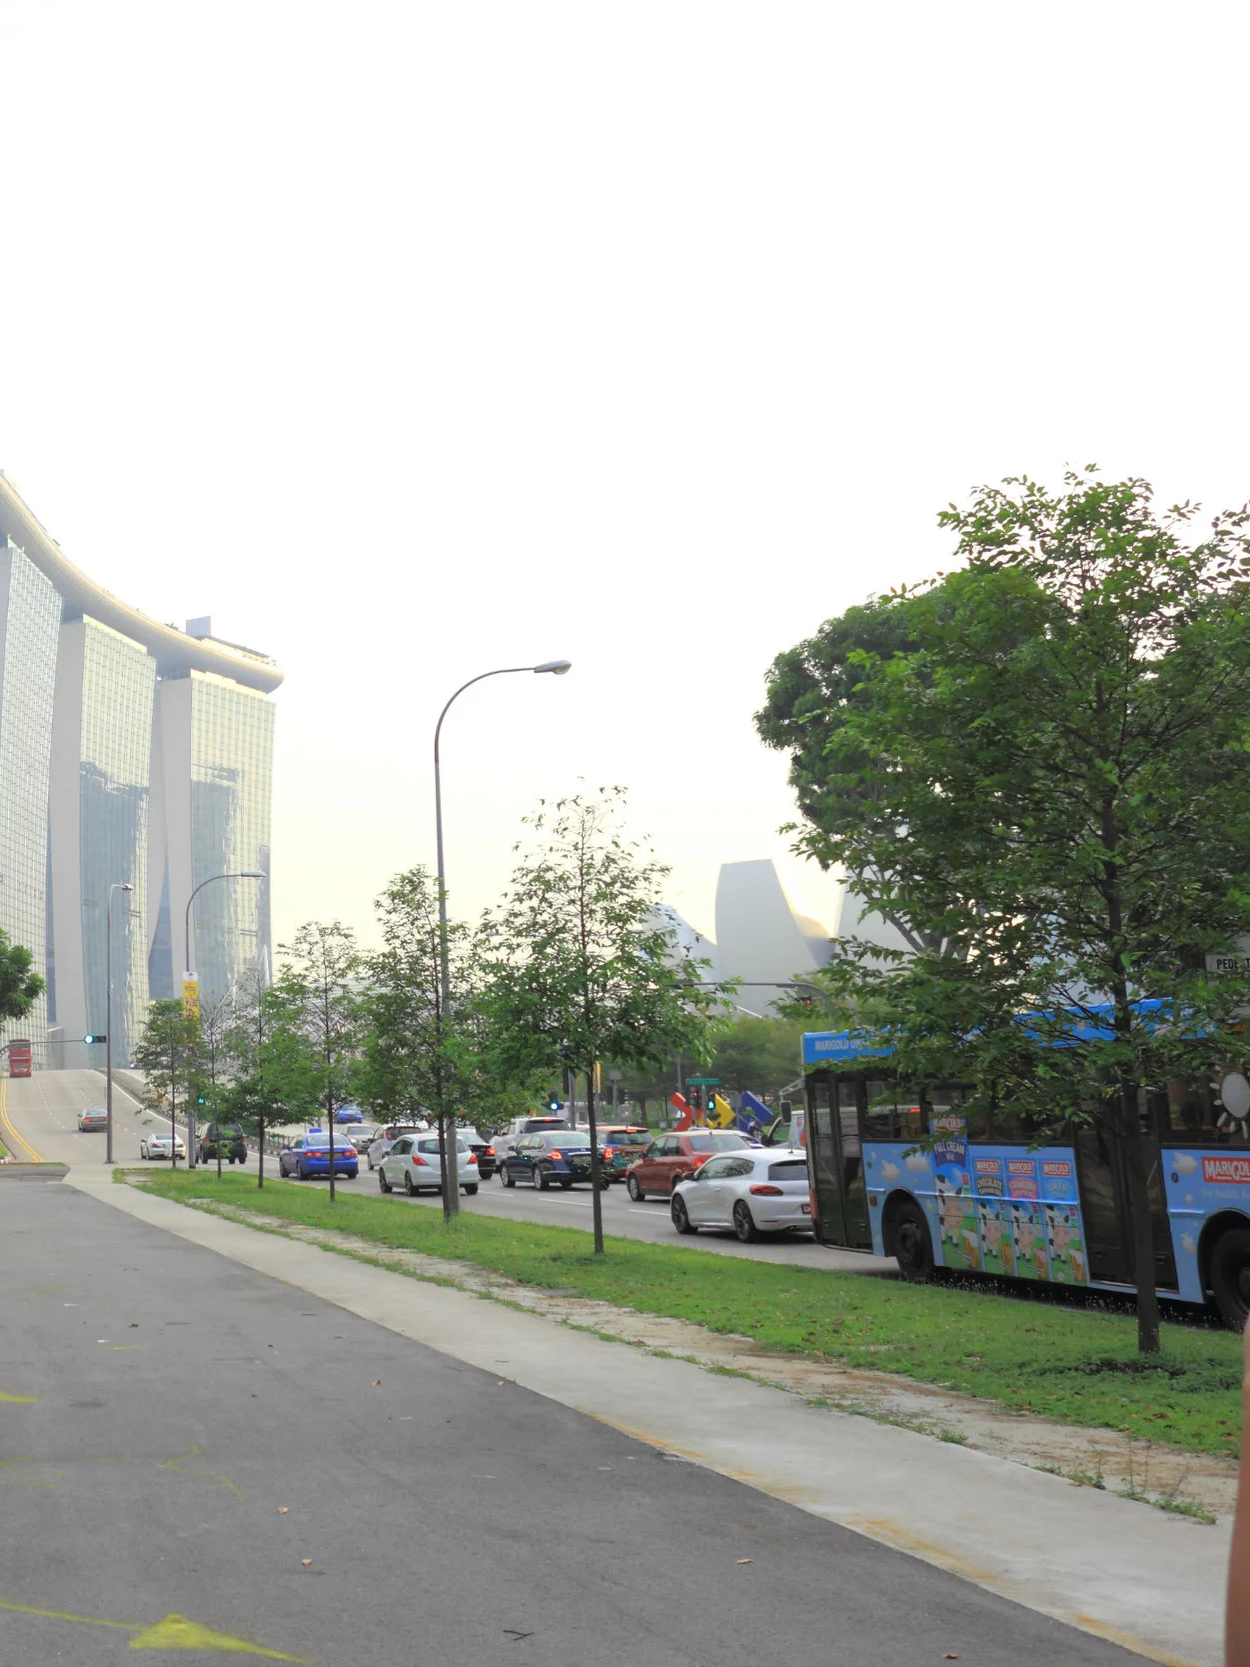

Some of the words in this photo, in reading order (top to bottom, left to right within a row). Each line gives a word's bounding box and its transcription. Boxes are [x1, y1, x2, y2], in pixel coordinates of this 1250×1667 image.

[1217, 958, 1250, 970] PEDET
[815, 1039, 849, 1051] MARIGOLD
[946, 1140, 965, 1156] CREAM
[977, 1177, 1002, 1190] CHOCOLATE
